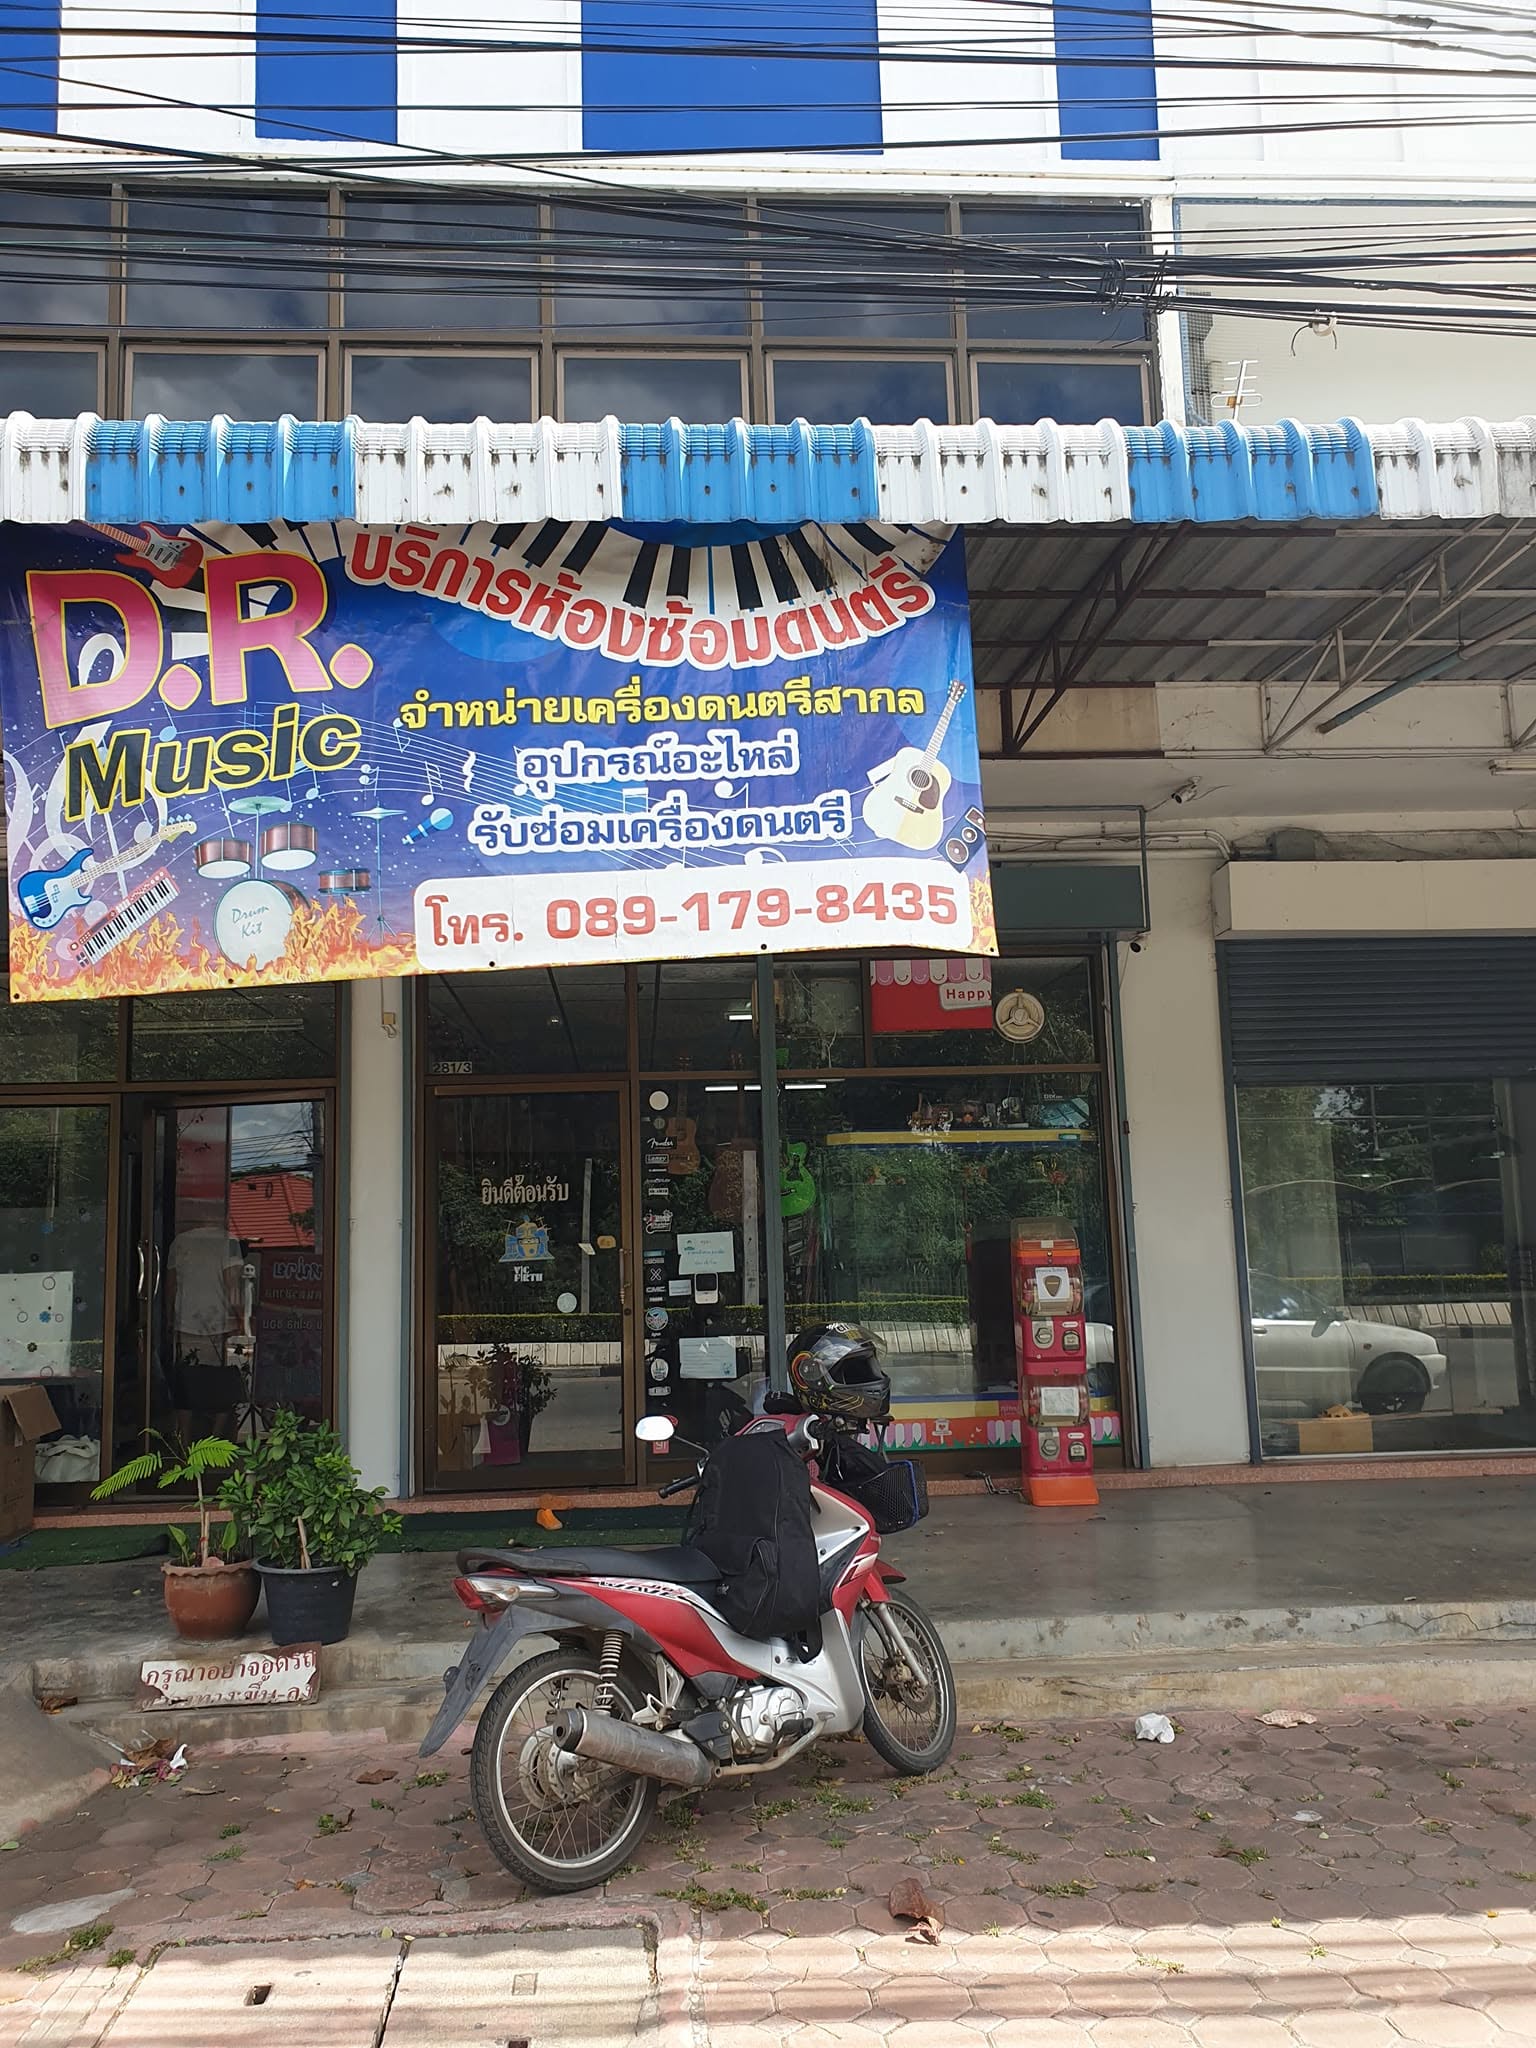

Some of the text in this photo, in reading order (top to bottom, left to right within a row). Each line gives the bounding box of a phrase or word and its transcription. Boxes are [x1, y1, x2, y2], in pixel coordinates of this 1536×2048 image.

[348, 531, 931, 665] บริการห้องซ้อมดนตรี
[26, 550, 373, 729] D.R.
[400, 677, 925, 729] จำหน่ายเครื่องดนตรีสากล
[65, 703, 361, 822] Music
[522, 734, 794, 790] อุปกรณ์อะไหล่
[473, 796, 848, 849] รับซ่อมเครื่องดนตรี
[232, 906, 270, 923] Drum
[241, 921, 262, 939] Kit
[424, 882, 957, 946] โทร. 089-179-8435
[432, 1062, 472, 1073] 281/3
[480, 1174, 570, 1205] ยินดีต้อนรับ
